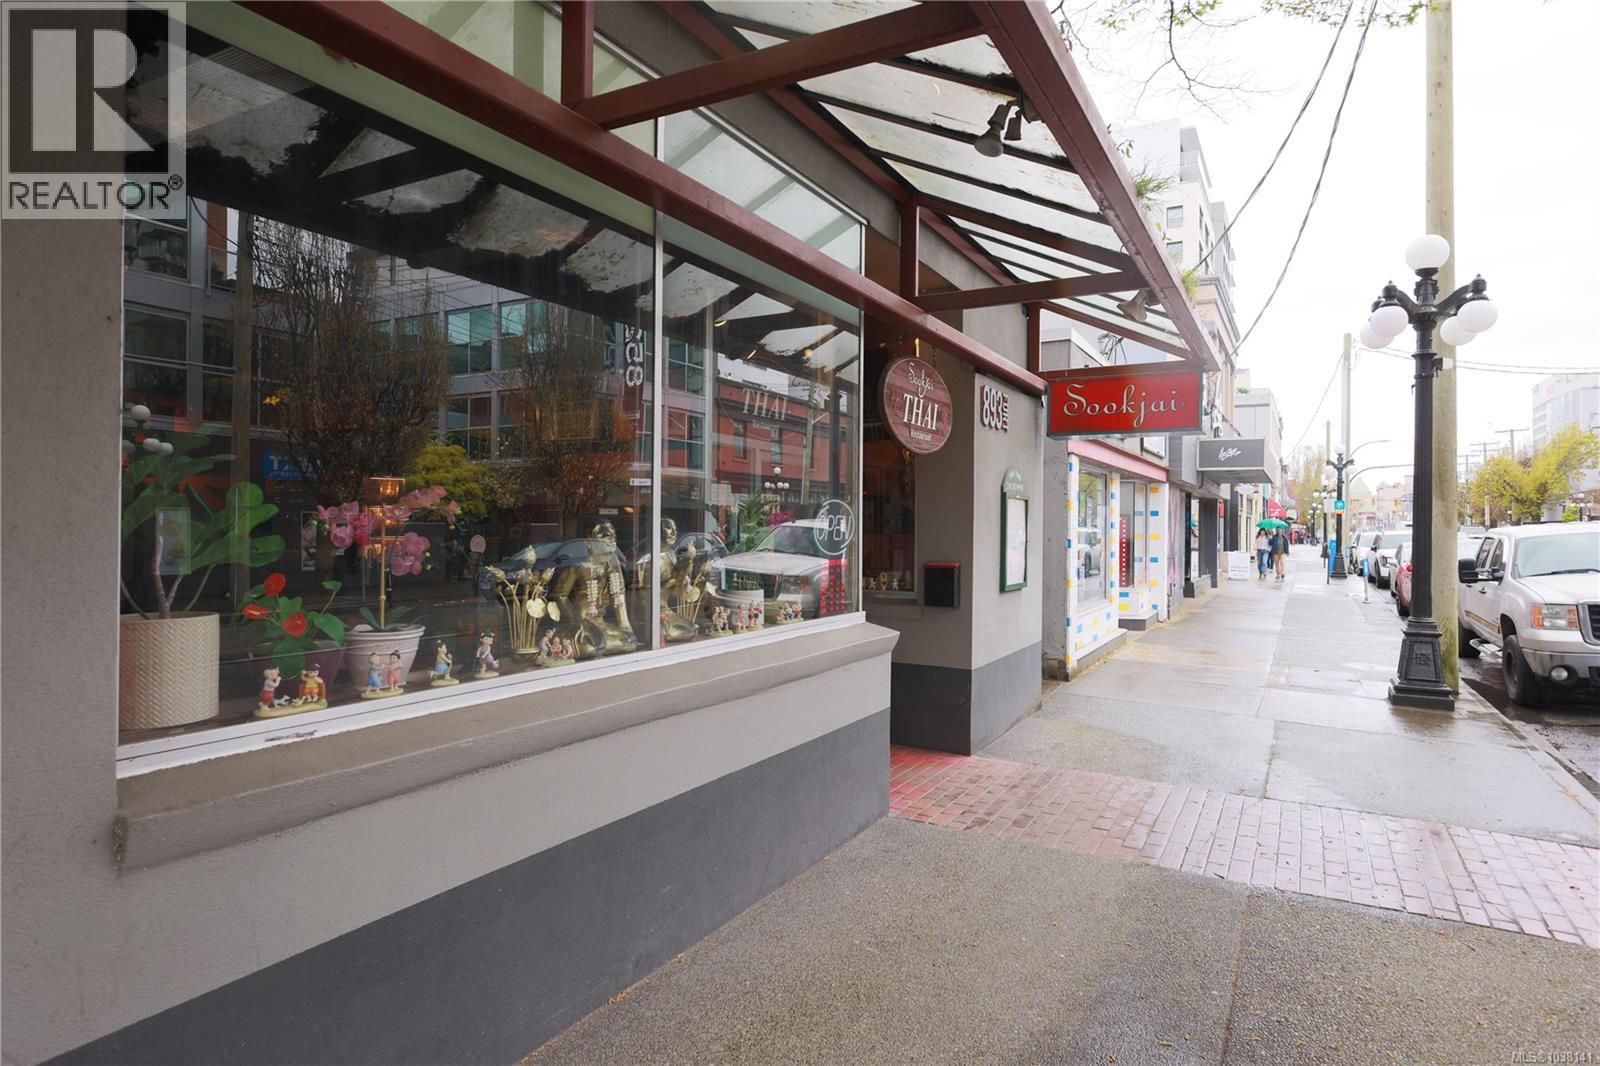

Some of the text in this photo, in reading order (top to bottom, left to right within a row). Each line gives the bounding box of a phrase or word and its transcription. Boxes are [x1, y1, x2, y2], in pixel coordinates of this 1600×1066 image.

[742, 387, 788, 421] THAI
[902, 392, 939, 431] THAI
[983, 385, 1003, 429] 893
[1063, 384, 1185, 428] Sookjai
[816, 514, 851, 541] OPEN
